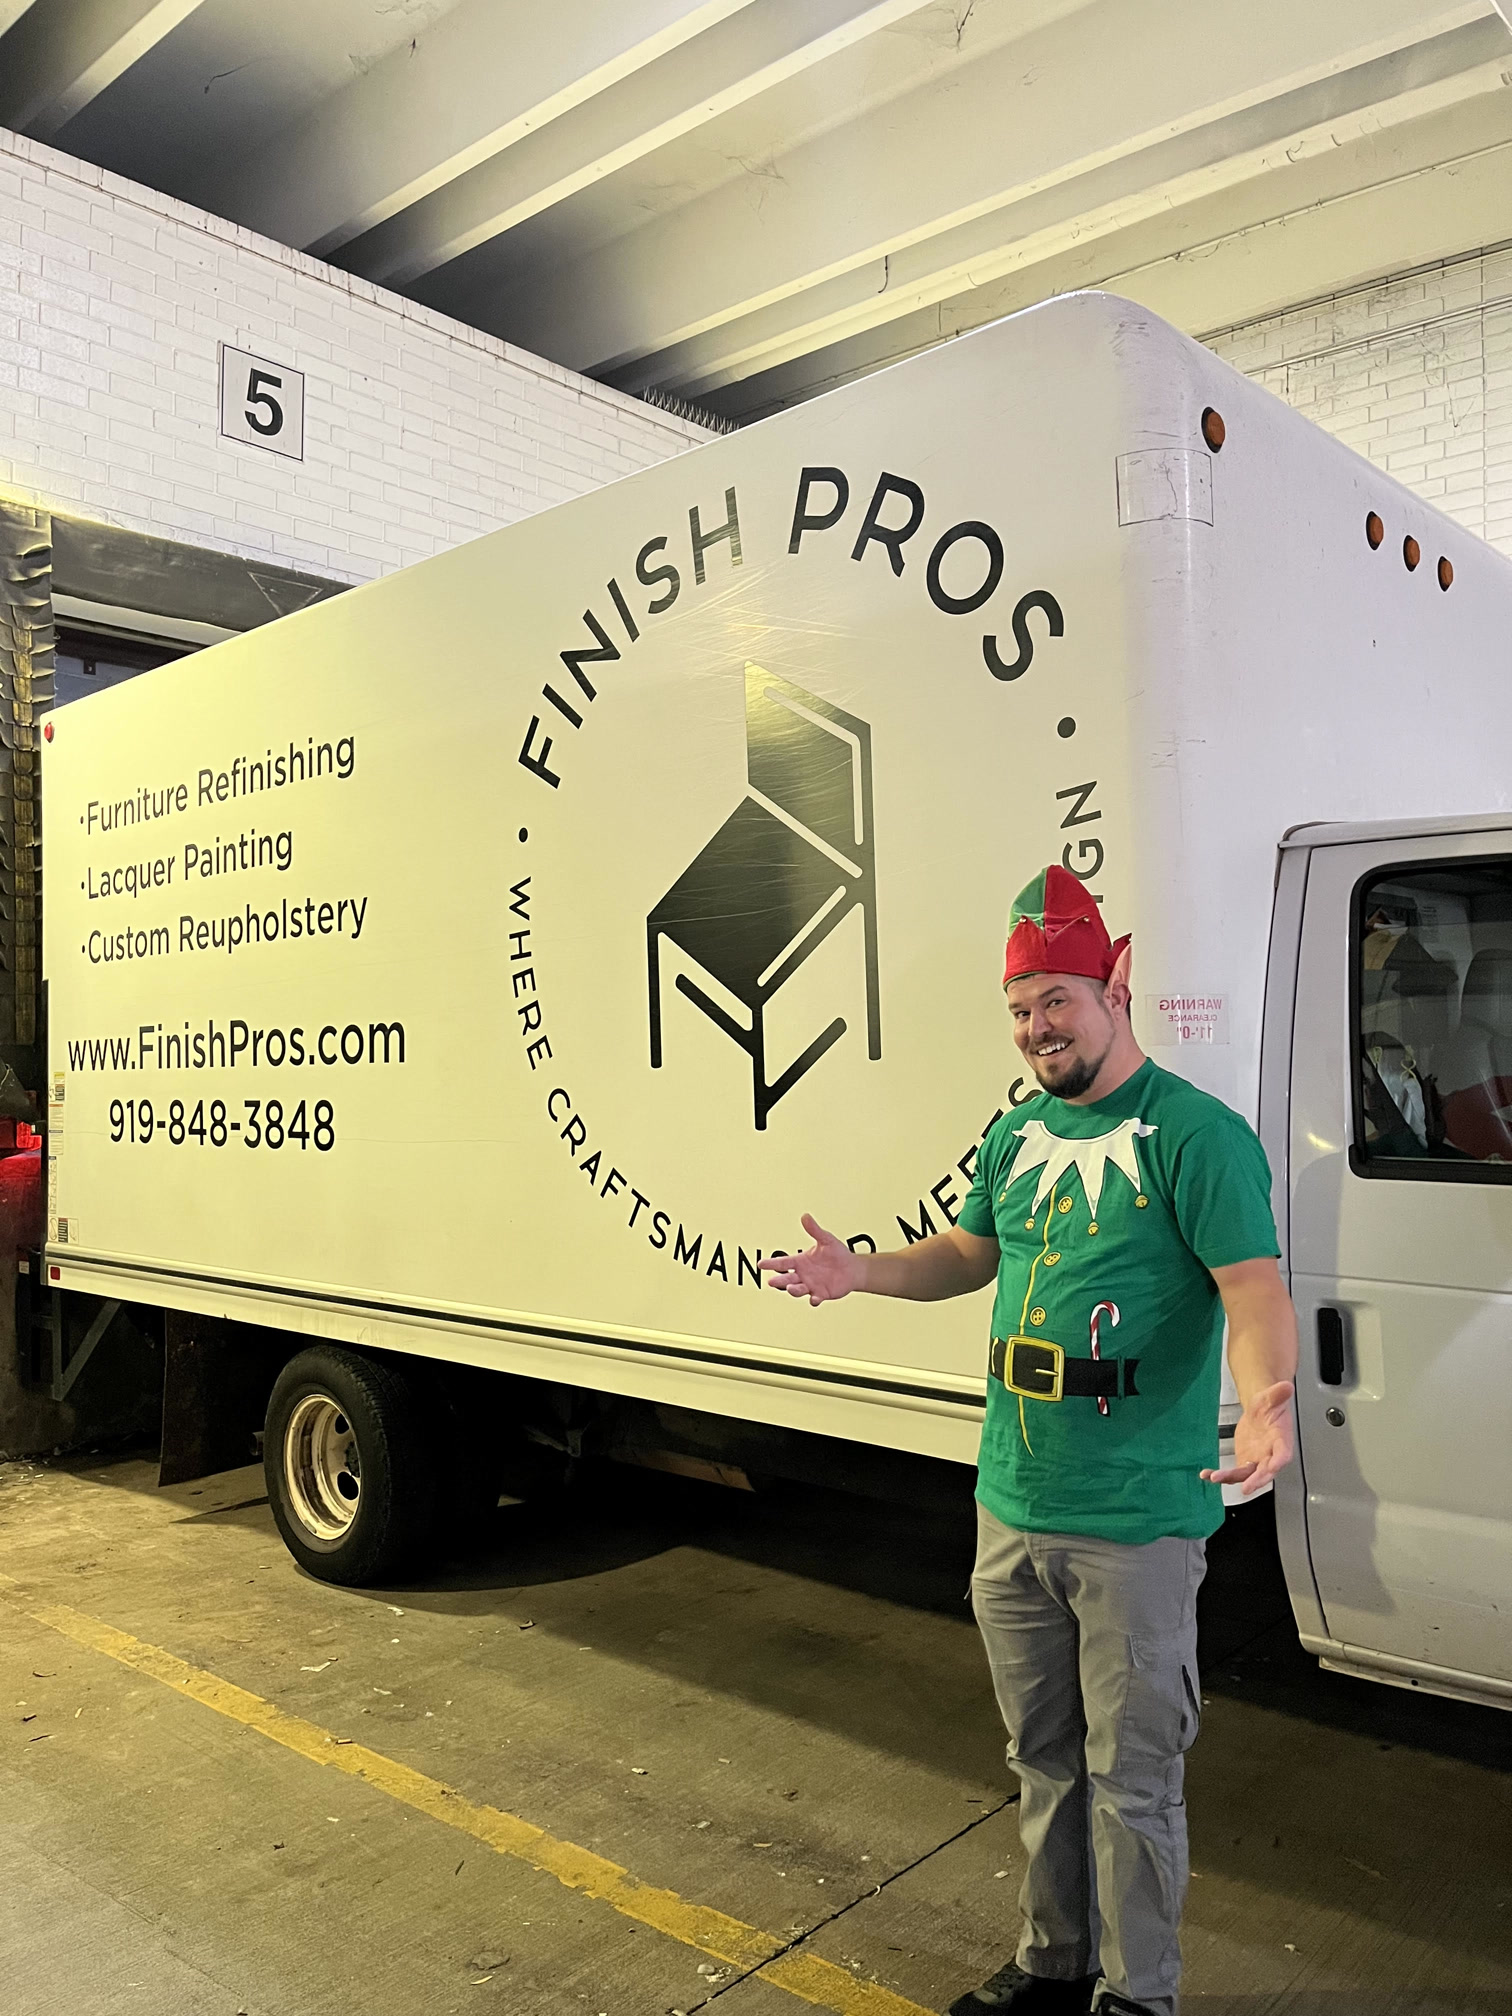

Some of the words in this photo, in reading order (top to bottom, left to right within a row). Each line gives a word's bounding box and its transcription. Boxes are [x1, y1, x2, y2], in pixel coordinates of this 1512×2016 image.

[245, 368, 284, 436] 5
[518, 486, 743, 789] FINISH
[788, 467, 1065, 682] PROS
[198, 736, 356, 806] Refinishing
[184, 829, 293, 881] Painting
[179, 897, 368, 954] Reupholstery
[508, 876, 553, 1071] WHERE
[67, 1019, 406, 1072] www.FinishPros.com
[109, 1099, 335, 1152] 919-848-3848
